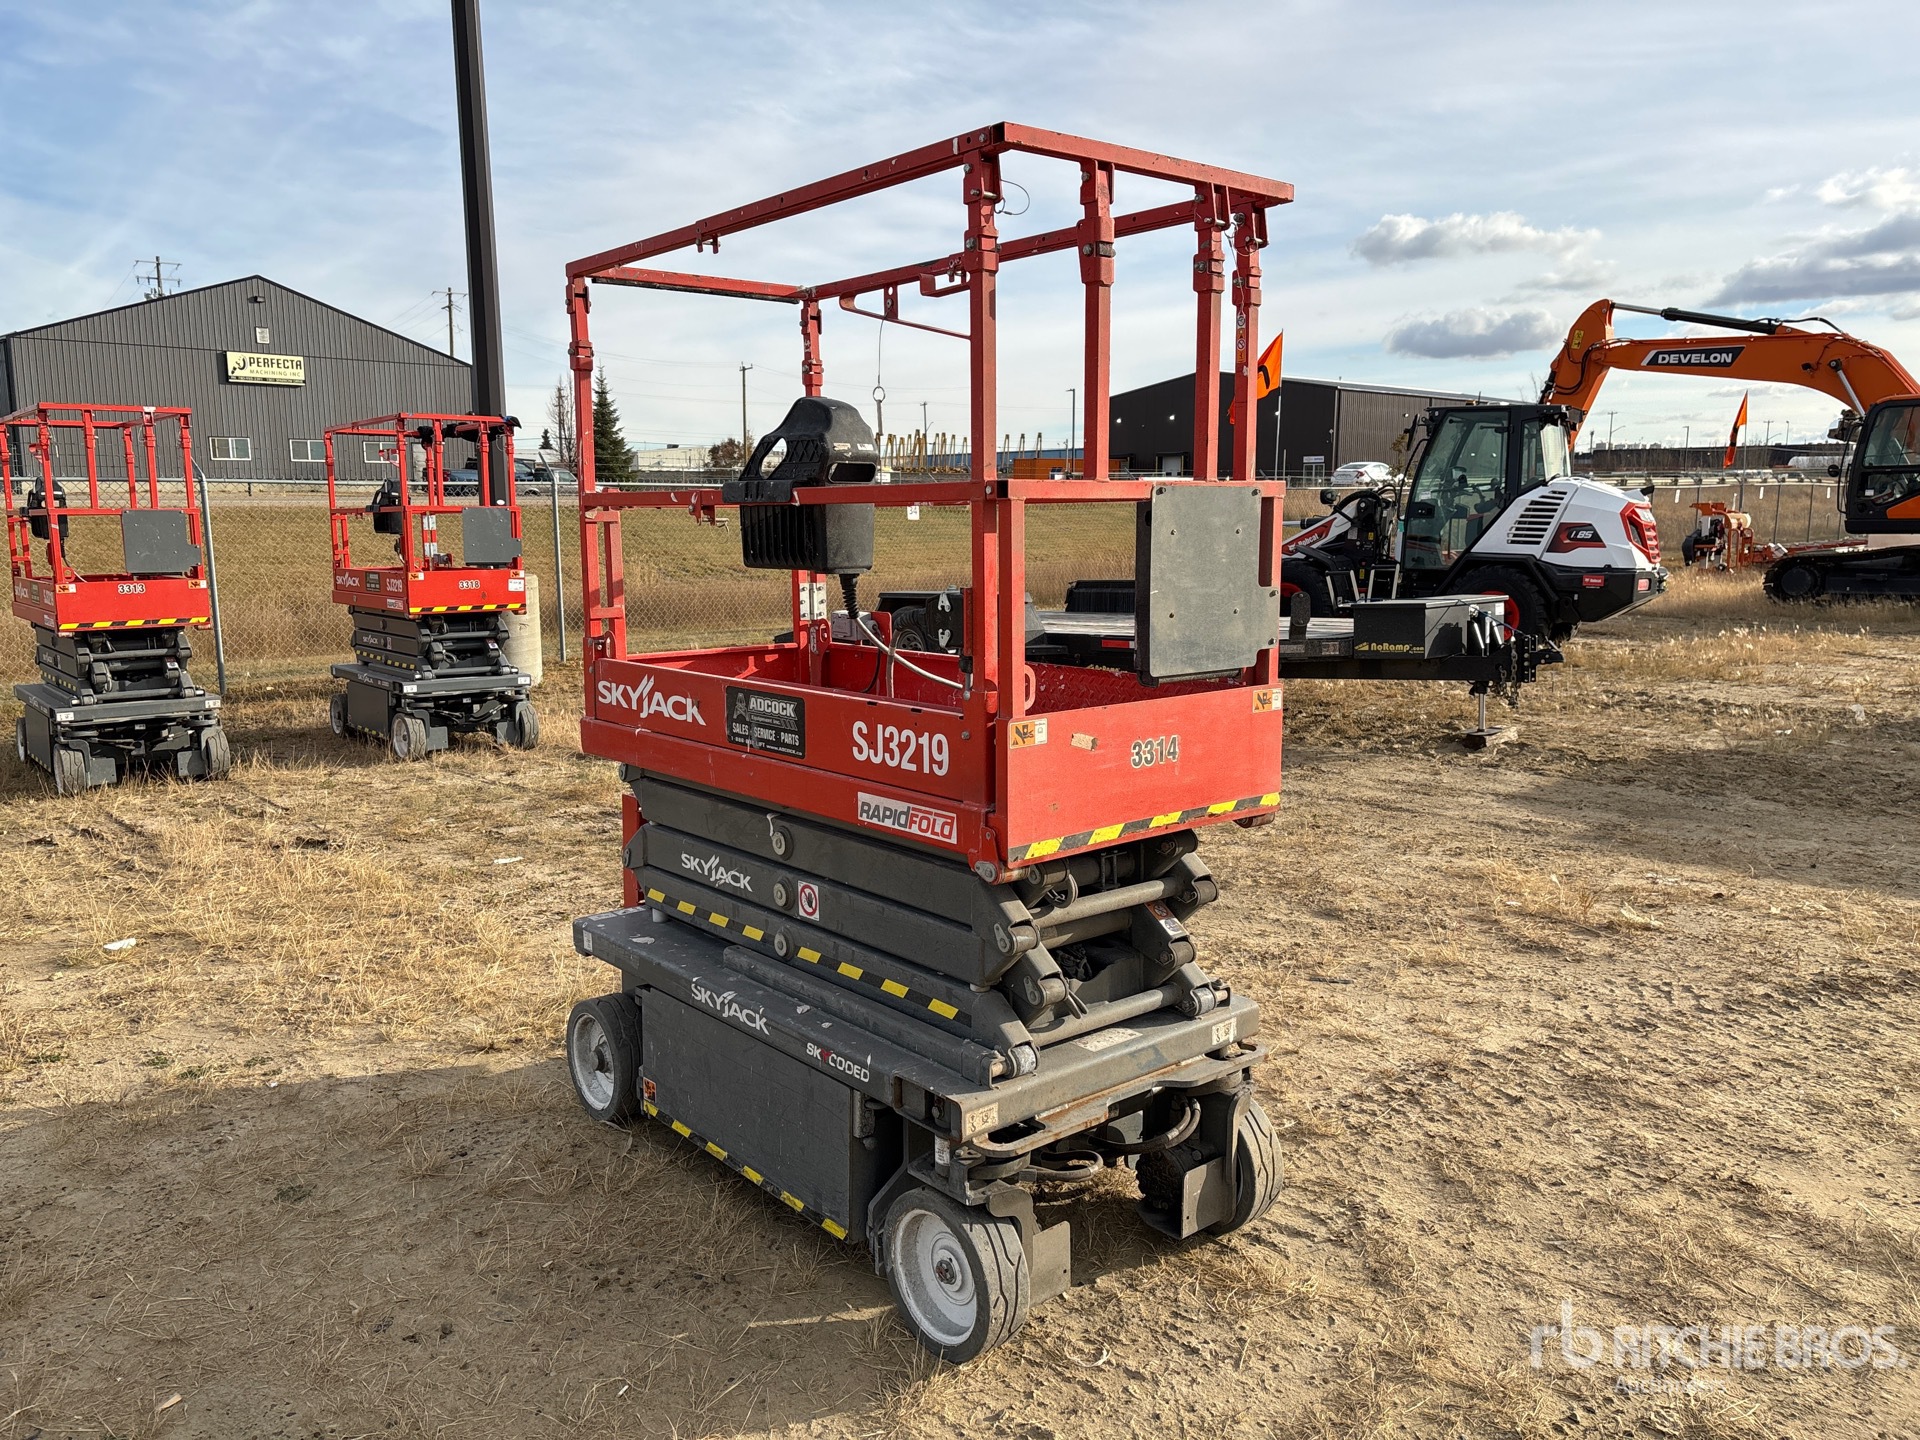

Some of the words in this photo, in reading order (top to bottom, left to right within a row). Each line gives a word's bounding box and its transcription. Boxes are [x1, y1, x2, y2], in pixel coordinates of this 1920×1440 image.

[248, 356, 302, 370] PERFECTA
[1657, 353, 1733, 364] DEVELON
[117, 583, 146, 594] 3313
[458, 579, 481, 590] 3318
[597, 673, 707, 726] SKYJACK
[749, 697, 796, 718] ADCOCK
[732, 722, 749, 735] SALES
[753, 727, 776, 741] SERVICE
[780, 732, 800, 746] PARTS
[852, 720, 950, 776] SJ3219
[1129, 734, 1180, 769] 3314
[680, 854, 753, 892] SKYJACK
[690, 978, 770, 1036] SKYJACK
[806, 1042, 870, 1083] SKYCODED
